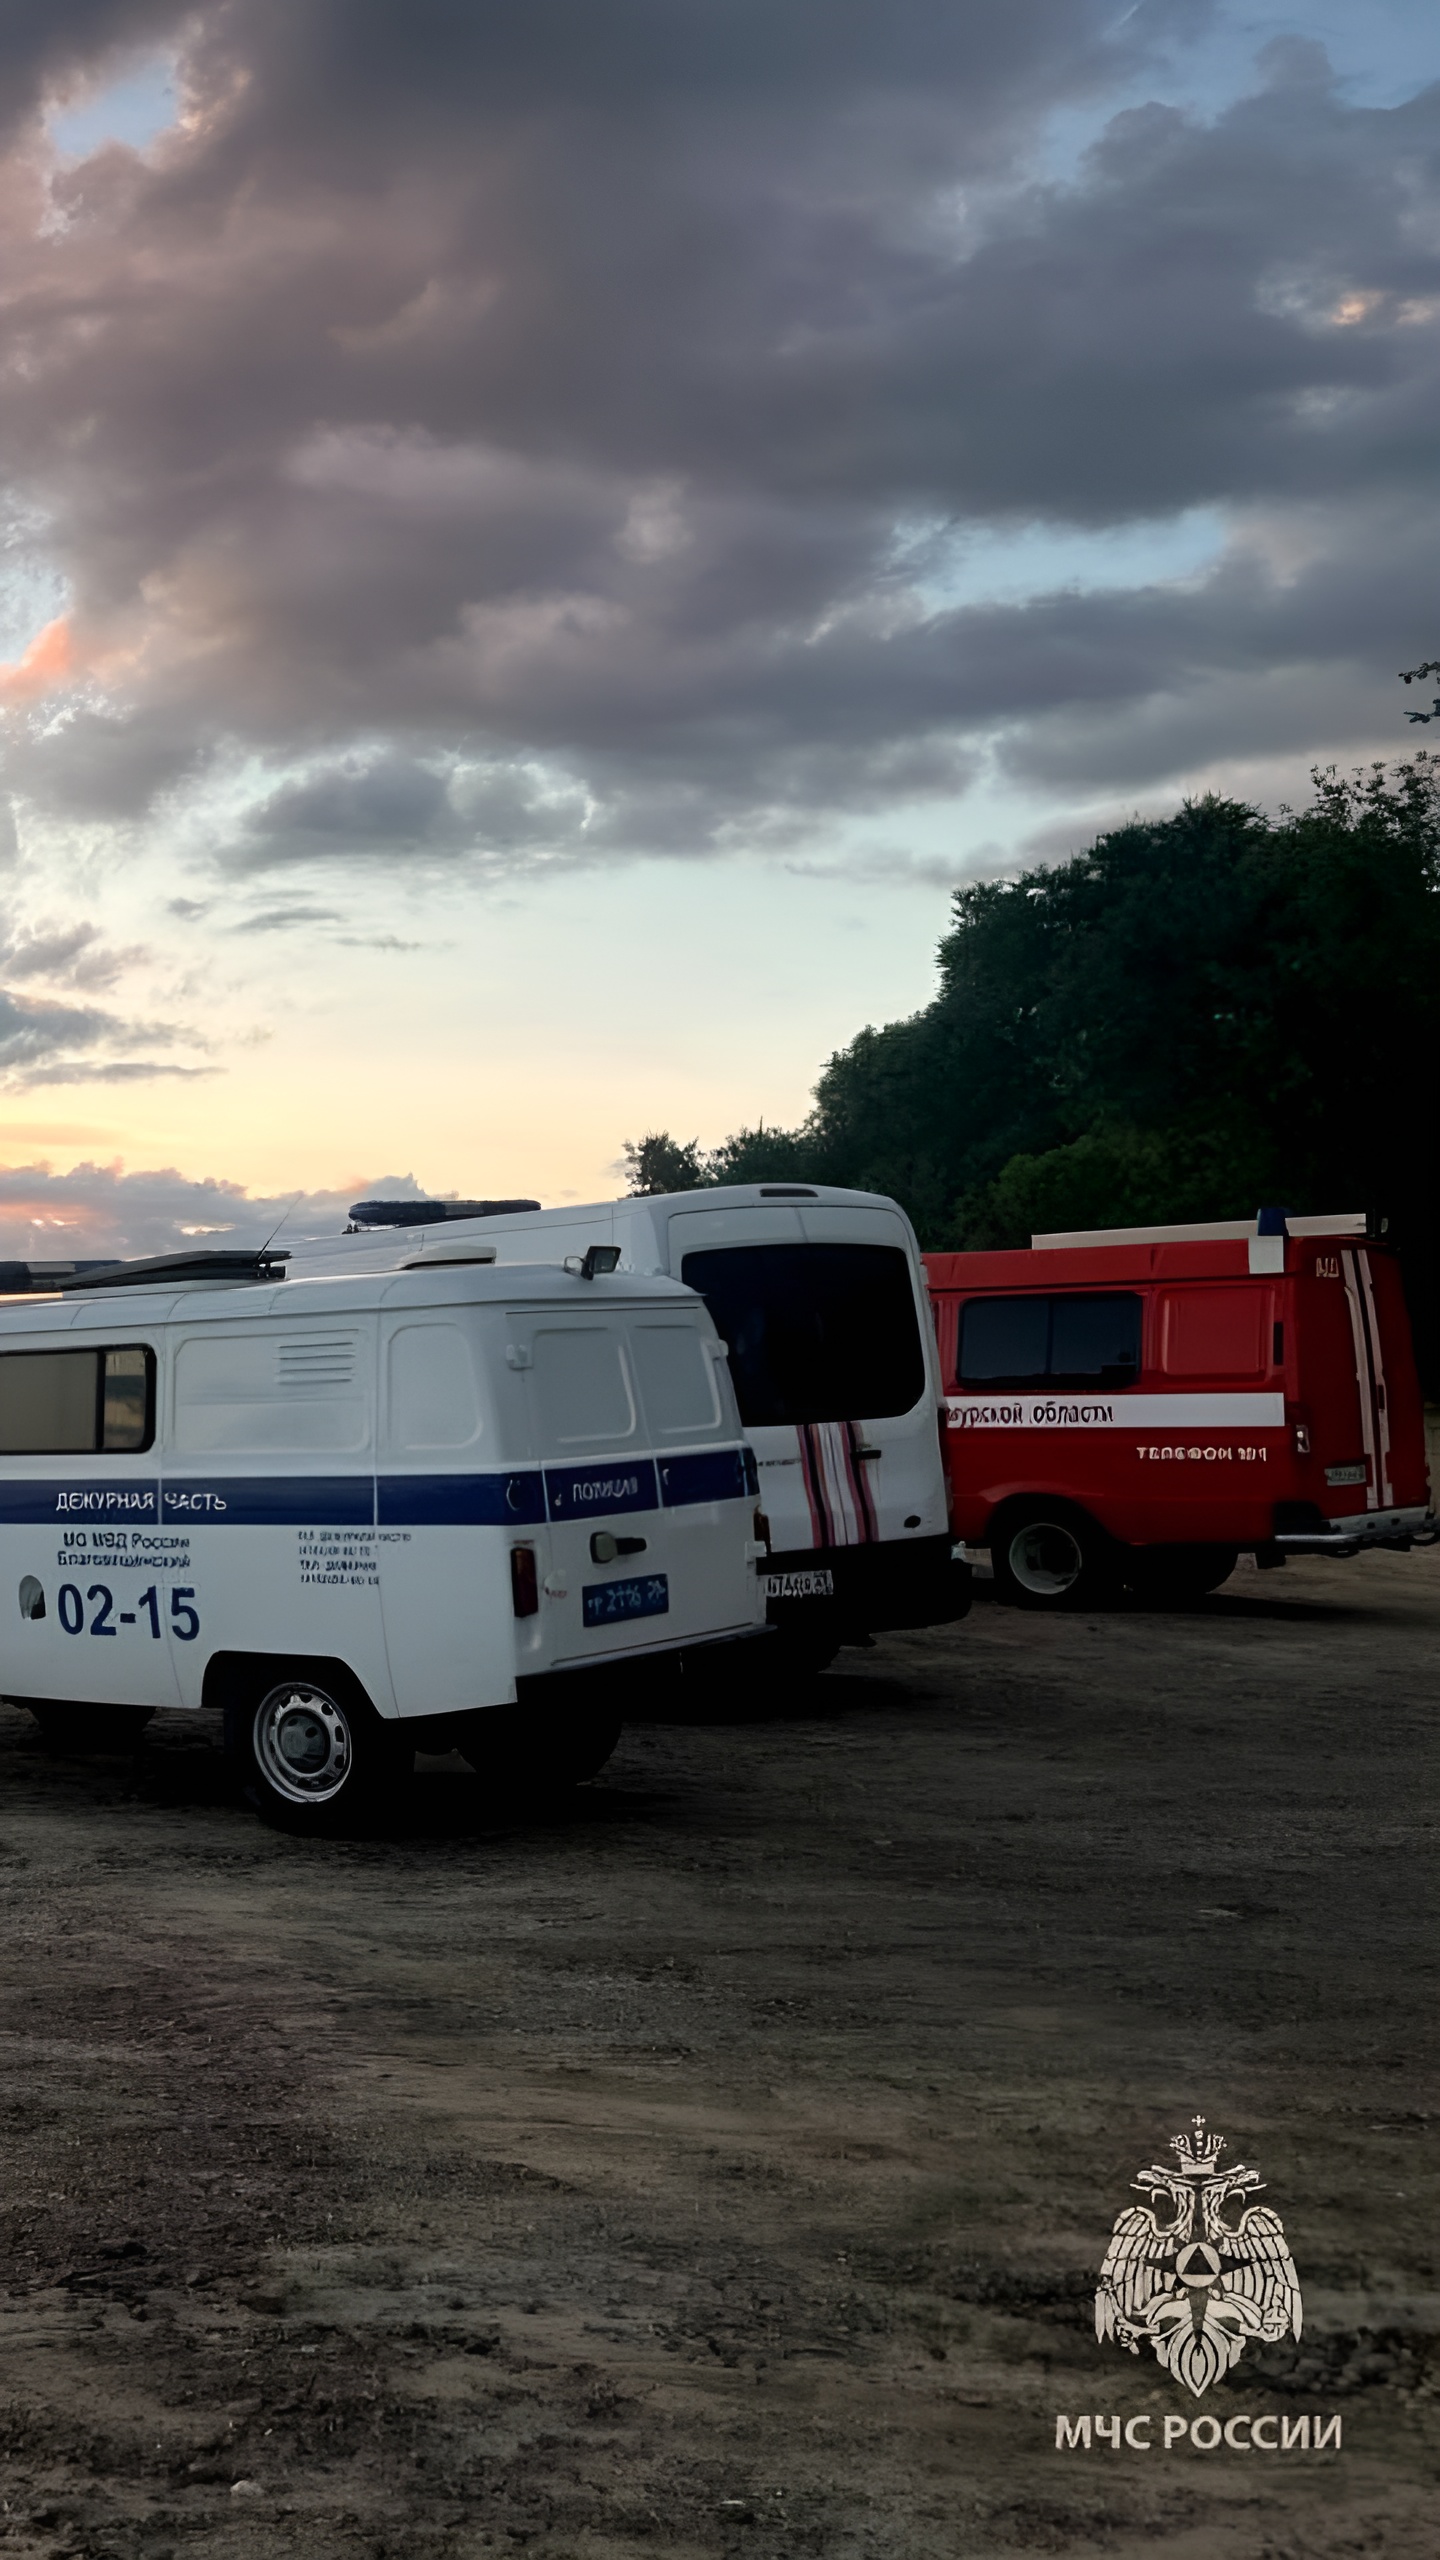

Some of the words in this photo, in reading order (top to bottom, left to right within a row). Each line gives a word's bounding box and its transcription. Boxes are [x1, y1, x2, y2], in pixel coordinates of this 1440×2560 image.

[1032, 1401, 1114, 1424] области
[164, 1492, 227, 1510] ЧАСТЬ
[58, 1583, 200, 1640] 02-15
